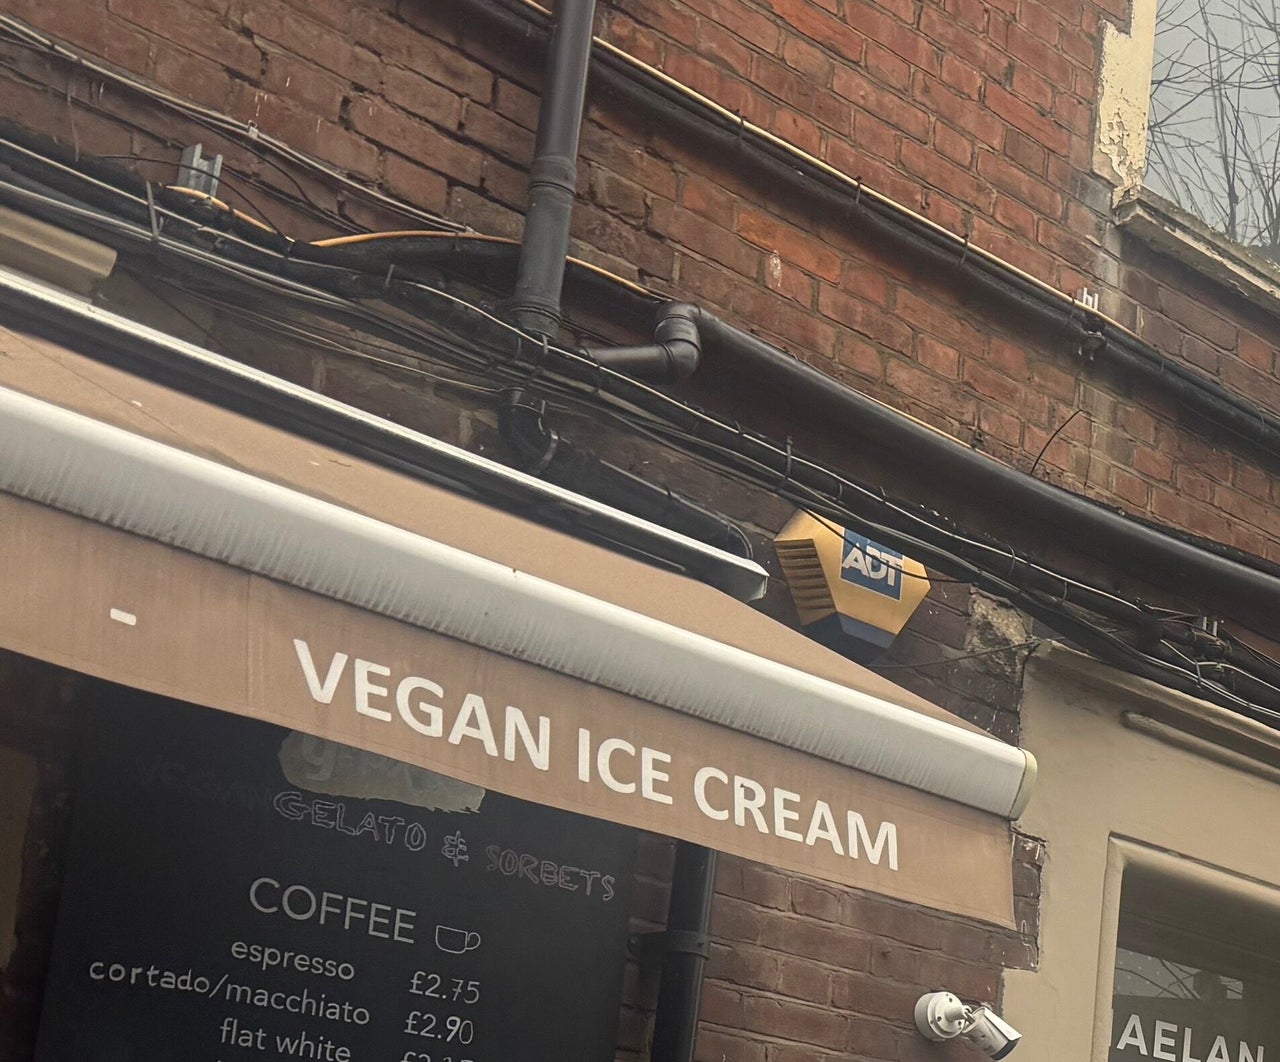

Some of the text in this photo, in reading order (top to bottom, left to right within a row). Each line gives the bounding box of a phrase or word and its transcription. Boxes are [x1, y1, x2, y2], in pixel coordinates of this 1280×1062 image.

[842, 543, 903, 586] ADT
[293, 639, 550, 772] VEGAN
[577, 728, 672, 805] ICE
[692, 767, 899, 871] CREAM
[272, 790, 427, 852] GELATO
[484, 844, 616, 902] SORBETS
[249, 878, 416, 944] COFFEE
[89, 960, 474, 1044] cortado/macchiato £2.90
[231, 938, 480, 1004] espresso £2.75
[220, 1018, 266, 1050] flat
